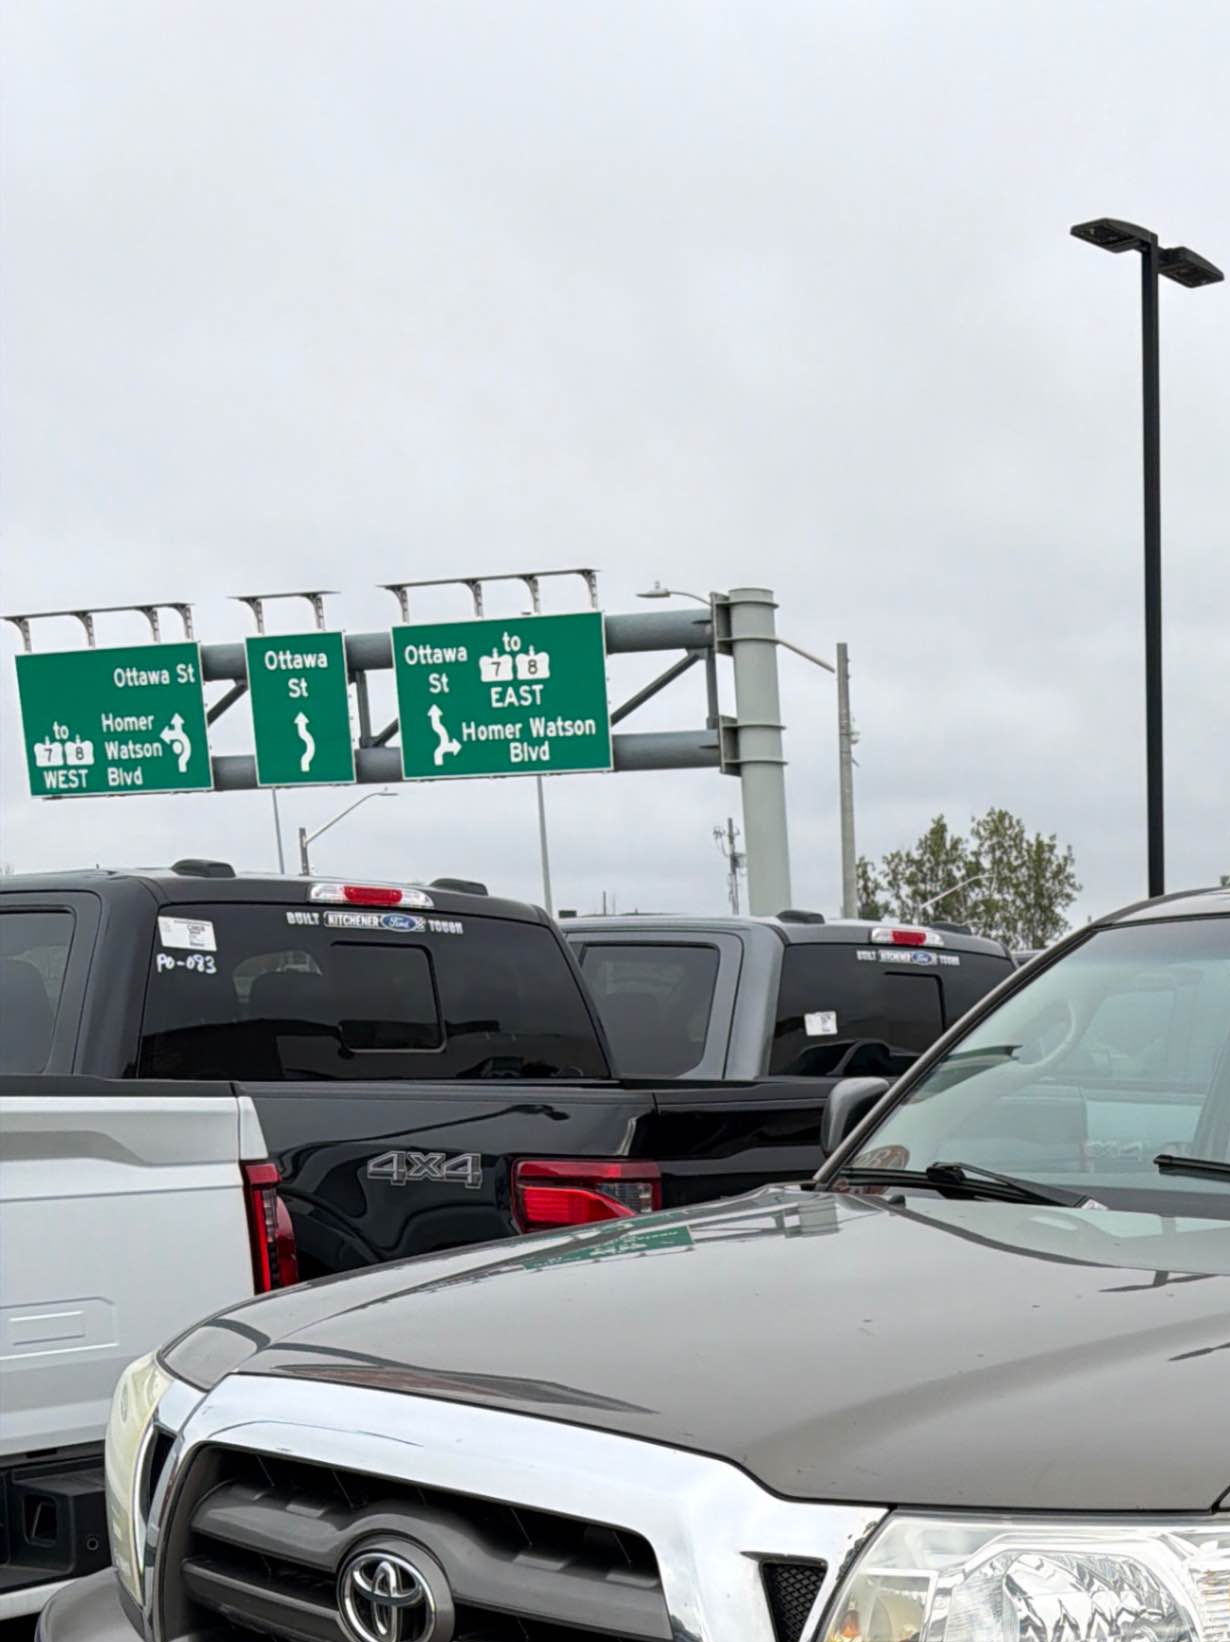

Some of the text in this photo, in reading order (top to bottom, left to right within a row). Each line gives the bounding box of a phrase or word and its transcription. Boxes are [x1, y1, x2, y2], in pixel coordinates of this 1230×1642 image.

[502, 631, 521, 652] to
[264, 650, 328, 671] Ottawa
[404, 644, 468, 666] Ottawa
[113, 663, 196, 688] Ottawa St
[491, 659, 538, 677] 7 8
[288, 677, 309, 698] St
[428, 673, 450, 694] St
[490, 684, 544, 708] EAST
[52, 721, 69, 740] to
[101, 713, 154, 732] Homer
[462, 716, 596, 742] Homer Watson
[45, 747, 85, 763] 7 8
[105, 740, 163, 761] Watson
[509, 741, 550, 763] Blvd
[43, 769, 88, 789] WEST
[107, 766, 143, 787] Blvd
[286, 912, 320, 926] BUILT
[328, 913, 380, 928] KITCHENER
